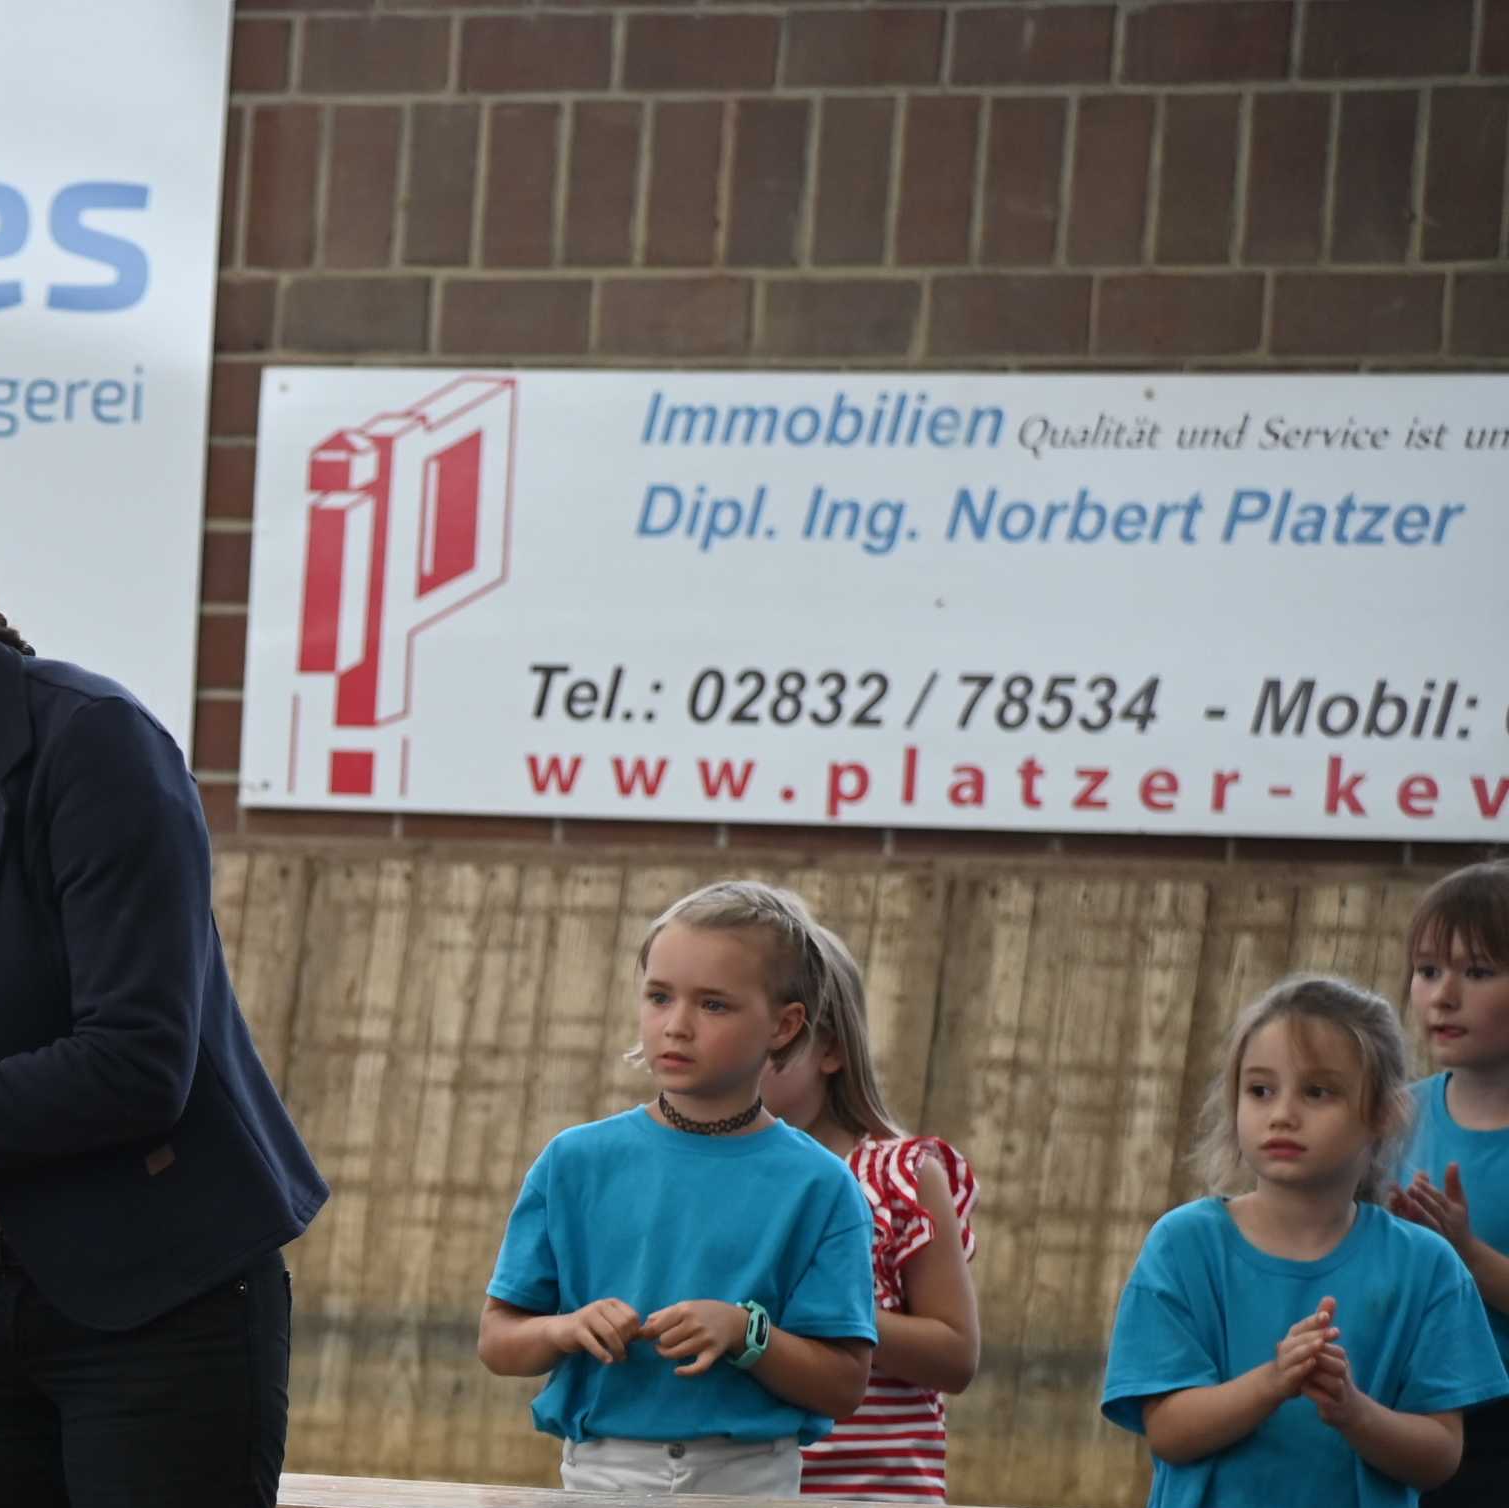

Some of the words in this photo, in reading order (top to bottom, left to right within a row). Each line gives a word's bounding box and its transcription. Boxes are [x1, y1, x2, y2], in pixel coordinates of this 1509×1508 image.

[641, 391, 1006, 449] Immobilien
[1017, 412, 1163, 459] Qualität
[1176, 412, 1251, 450] und
[1257, 418, 1391, 451] Service
[1403, 420, 1450, 451] ist
[635, 483, 777, 552] Dipl.
[802, 486, 919, 556] Ing.
[946, 487, 1205, 545] Norbert
[1222, 487, 1469, 546] Platzer
[528, 664, 664, 722] Tel.:
[1249, 677, 1479, 740] Mobil:
